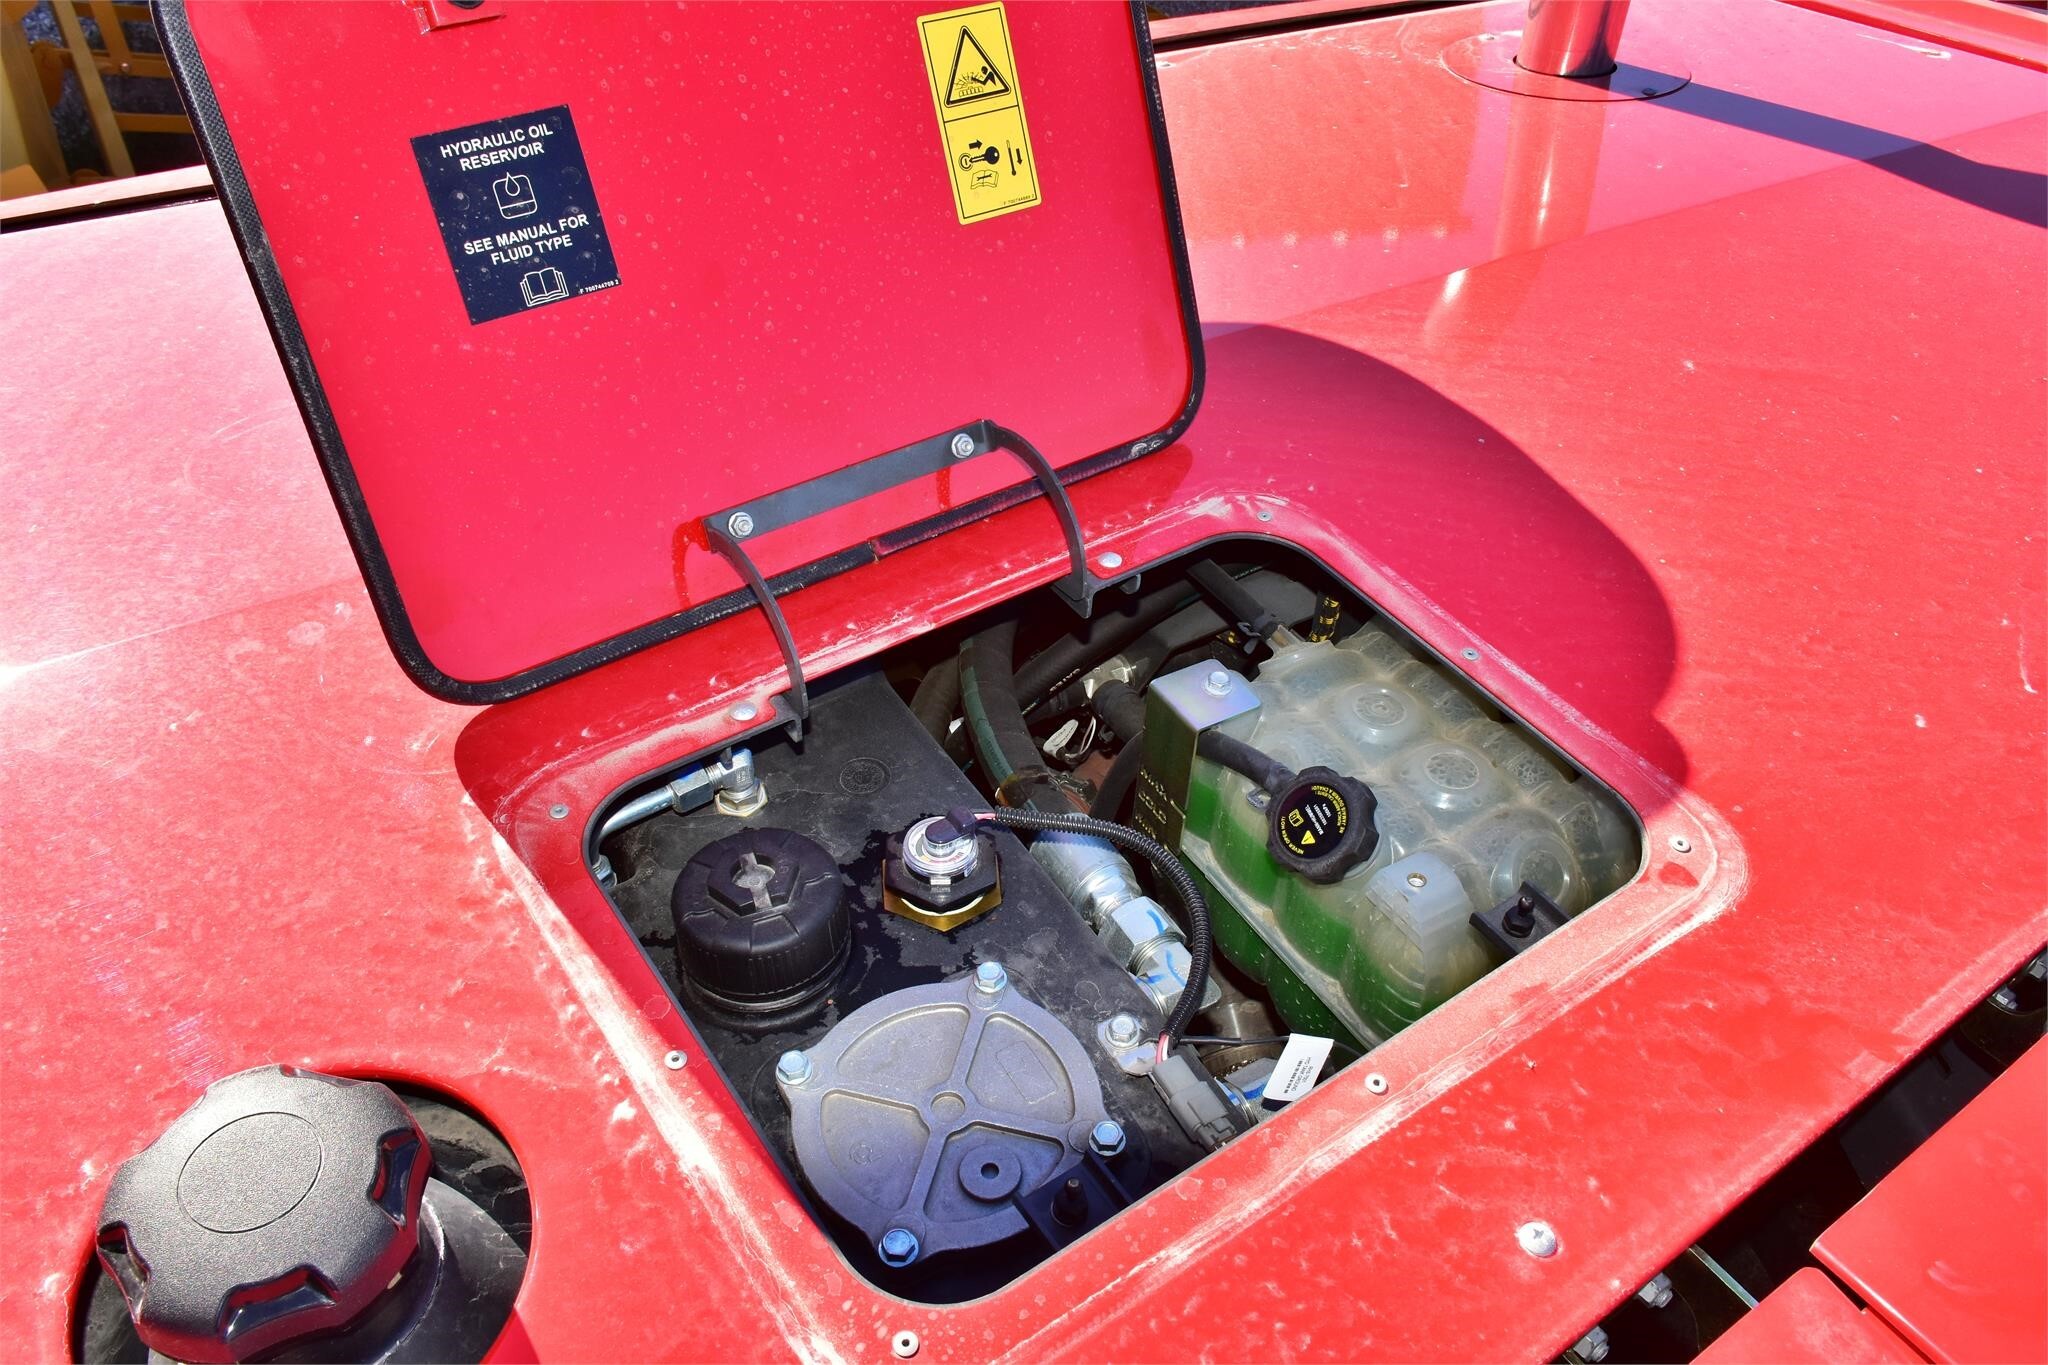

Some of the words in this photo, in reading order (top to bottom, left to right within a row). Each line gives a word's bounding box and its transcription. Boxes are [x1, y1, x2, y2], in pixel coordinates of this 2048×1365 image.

[440, 129, 526, 158] HYDRAULIC
[528, 123, 554, 138] OIL
[459, 141, 545, 171] RESERVOIR
[464, 237, 494, 255] SEE
[495, 222, 558, 248] MANUAL
[558, 214, 590, 231] FOR
[491, 245, 534, 265] FLUID
[535, 234, 573, 253] TYPE
[1281, 830, 1291, 844] OPEN
[1288, 843, 1304, 854] NEVER
